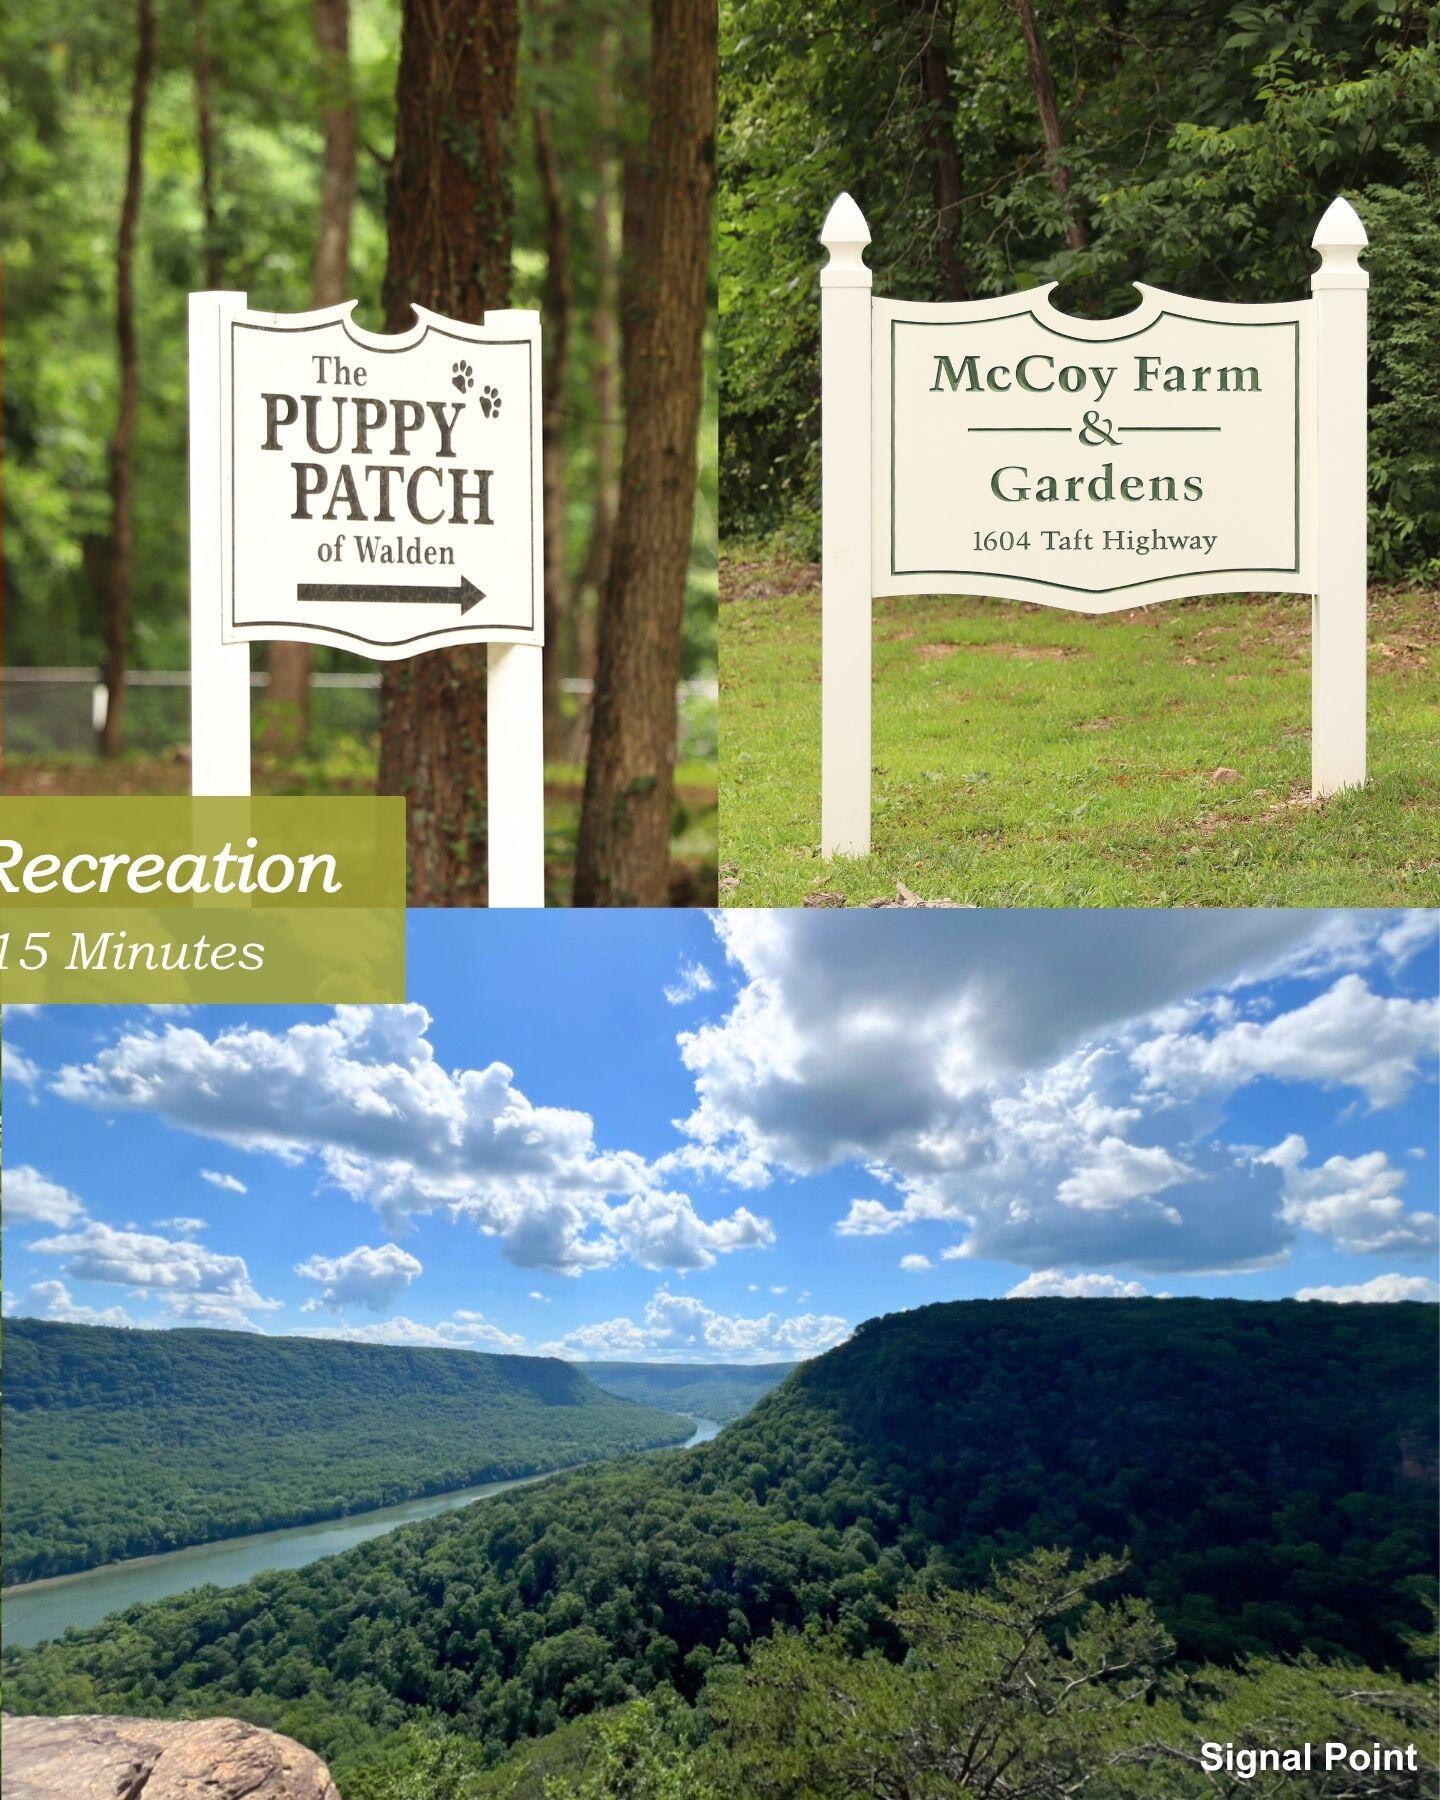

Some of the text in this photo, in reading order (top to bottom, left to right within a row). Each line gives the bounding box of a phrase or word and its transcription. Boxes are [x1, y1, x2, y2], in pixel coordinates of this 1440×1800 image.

[311, 355, 368, 386] The
[929, 354, 1263, 402] McCoy Farm
[260, 393, 466, 458] PUPPY
[1077, 410, 1123, 447] &
[290, 462, 495, 526] PATCH
[990, 462, 1204, 503] Gardens
[317, 534, 456, 565] of Walden
[972, 528, 1218, 556] 1604 Taft Highway
